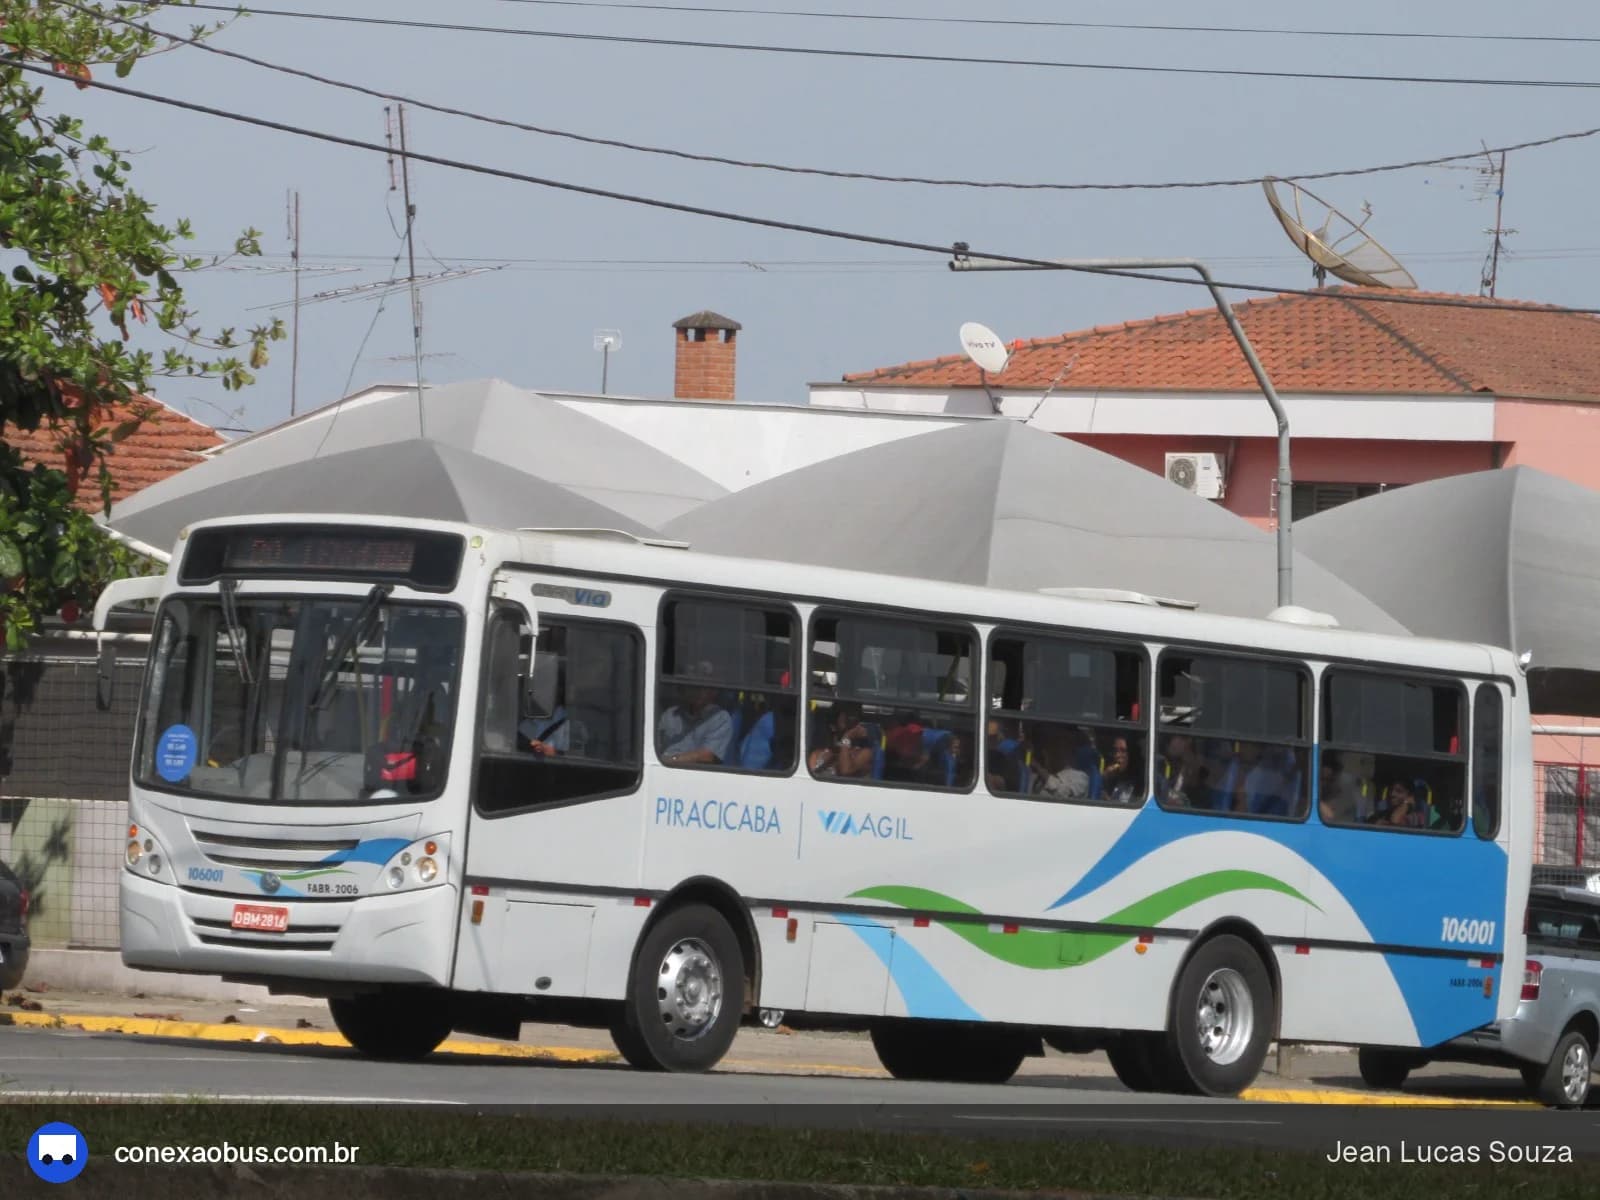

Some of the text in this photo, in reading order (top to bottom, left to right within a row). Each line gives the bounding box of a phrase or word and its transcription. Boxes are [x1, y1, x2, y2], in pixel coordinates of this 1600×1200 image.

[655, 797, 780, 834] PIRACICABA
[188, 867, 224, 883] 106001
[1440, 917, 1496, 945] 106001
